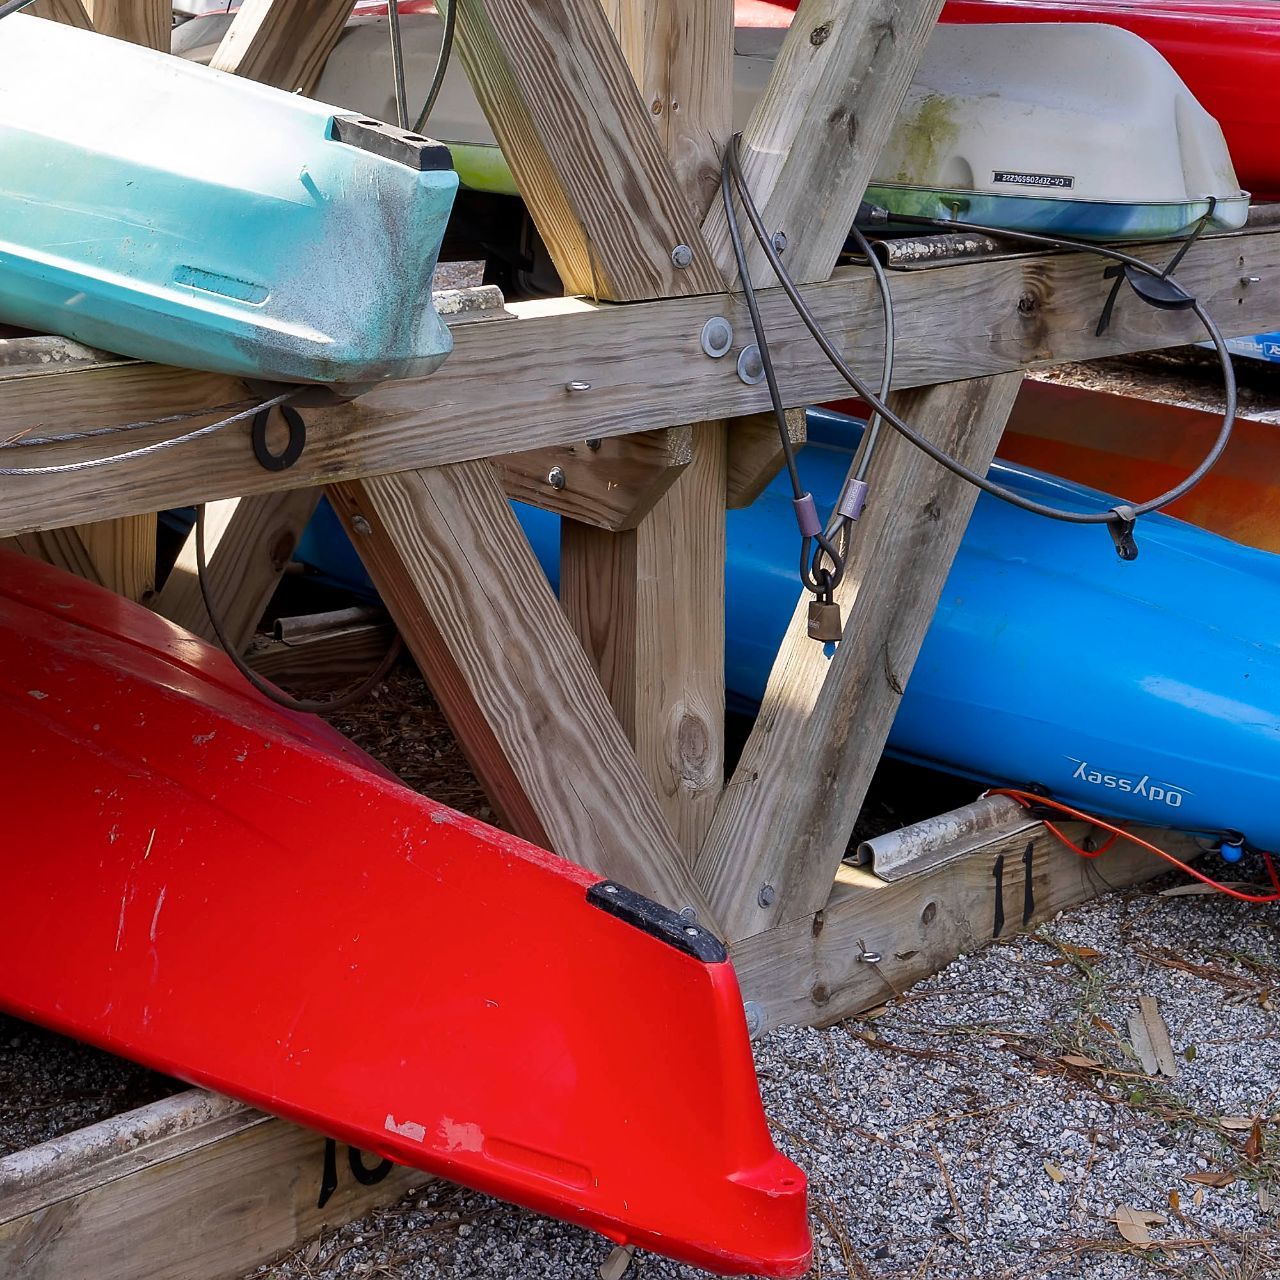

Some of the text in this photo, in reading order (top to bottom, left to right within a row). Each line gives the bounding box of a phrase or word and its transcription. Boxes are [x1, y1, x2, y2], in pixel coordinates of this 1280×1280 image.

[1095, 264, 1129, 337] 7
[1073, 761, 1182, 807] Odyssey
[992, 841, 1035, 938] 11
